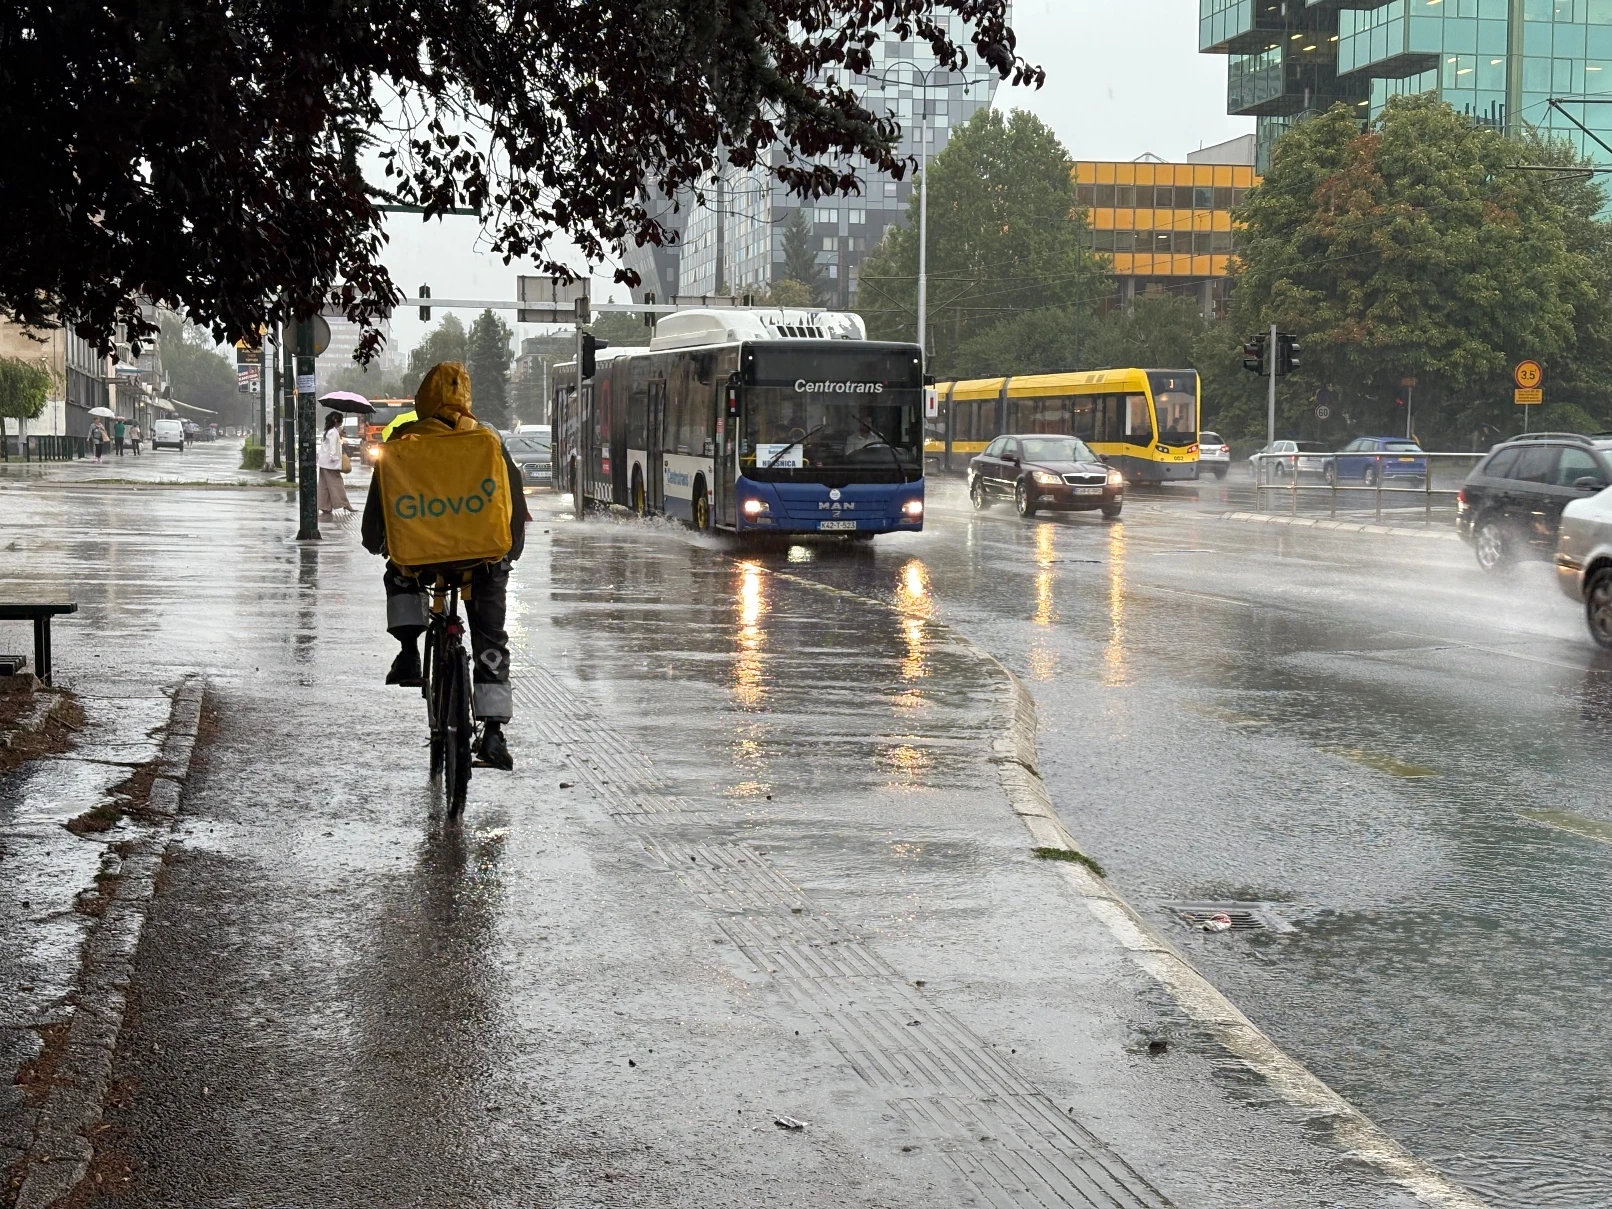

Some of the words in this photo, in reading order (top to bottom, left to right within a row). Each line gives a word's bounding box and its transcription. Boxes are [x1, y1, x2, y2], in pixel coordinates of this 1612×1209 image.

[794, 378, 884, 393] Centrotrans
[1318, 408, 1328, 417] 60
[394, 494, 484, 520] Glovo
[818, 502, 855, 510] MAN
